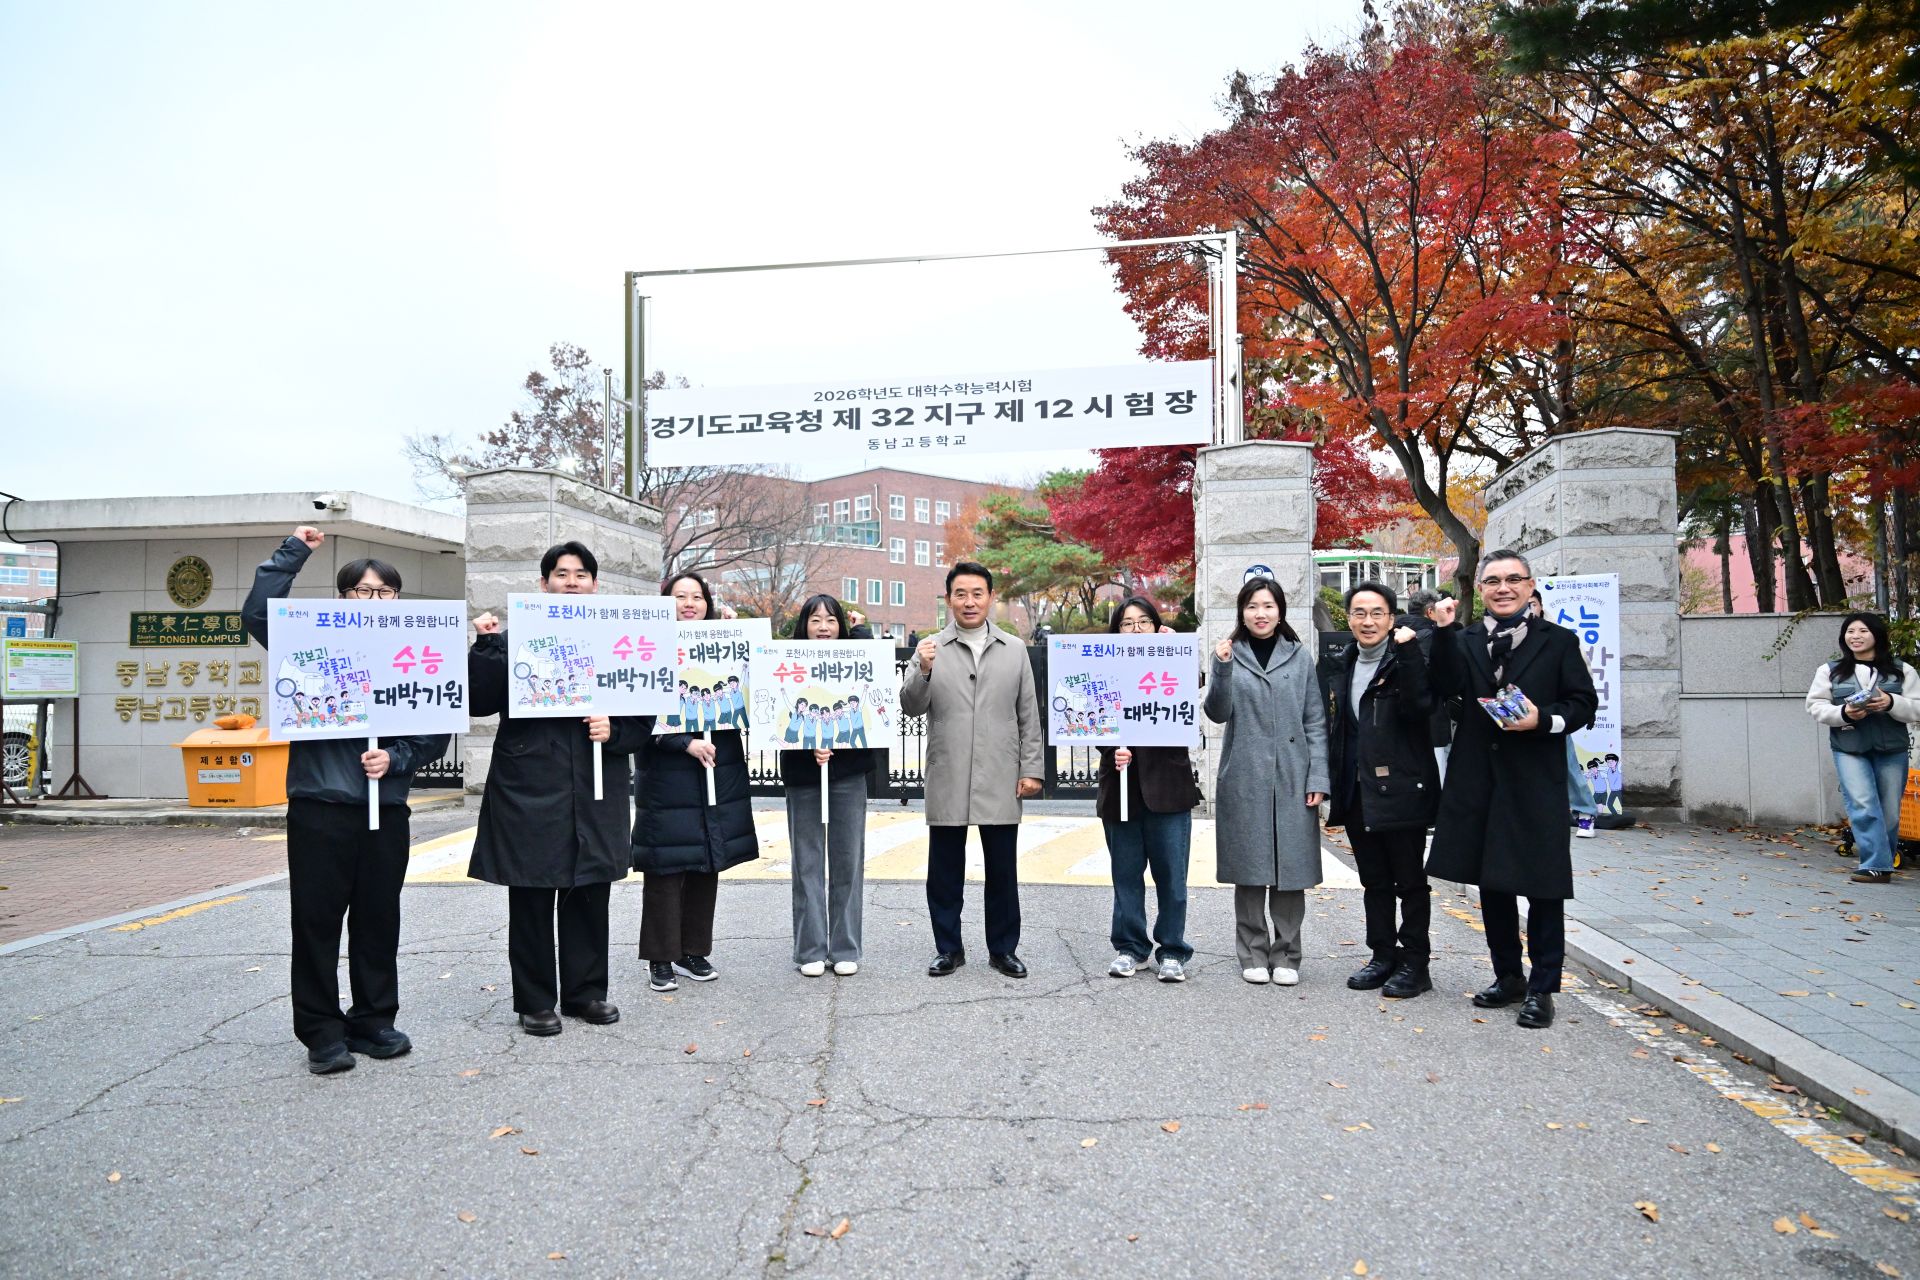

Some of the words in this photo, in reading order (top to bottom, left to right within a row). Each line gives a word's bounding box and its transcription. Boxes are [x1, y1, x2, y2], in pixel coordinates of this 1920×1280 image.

[814, 387, 903, 402] 2026학년도
[908, 379, 1032, 398] 대학수학능력시험
[651, 409, 823, 439] 경기도교육청
[832, 407, 861, 430] 제
[871, 407, 915, 427] 32
[924, 402, 985, 426] 지구
[994, 399, 1024, 423] 제
[1034, 399, 1074, 419] 12
[868, 435, 967, 450] 동남고등학교
[288, 610, 309, 618] 포천시
[316, 611, 375, 628] 포천시가
[377, 615, 400, 628] 함께
[403, 615, 460, 628] 응원합니다
[547, 605, 597, 620] 포천시가
[599, 608, 619, 620] 함께
[622, 609, 670, 620] 응원합니다
[10, 628, 22, 636] 69
[160, 635, 198, 643] DONGIN
[200, 634, 241, 643] CAMPUS
[694, 630, 708, 639] 함께
[709, 629, 743, 639] 응원합니다
[528, 635, 558, 652] 잘보고!
[613, 635, 657, 662] 수능
[689, 640, 750, 664] 대박기원
[1081, 644, 1124, 657] 포천시가
[1127, 646, 1145, 657] 함께
[1147, 646, 1192, 657] 응원합니다
[292, 646, 329, 667] 잘보고!
[392, 645, 444, 675] 수능
[549, 644, 578, 662] 잘풀고!
[786, 648, 815, 659] 포천시가
[817, 649, 831, 659] 함께
[832, 649, 866, 659] 응원합니다
[115, 659, 262, 687] 동남중학교
[317, 656, 352, 677] 잘풀고!
[563, 656, 595, 673] 잘찍고!
[772, 662, 807, 683] 수능
[811, 660, 873, 683] 대박기원
[334, 669, 371, 690] 잘찍고!
[596, 667, 674, 692] 대박기원
[1065, 672, 1091, 688] 잘보고!
[1082, 680, 1108, 696] 잘풀고!
[1138, 671, 1179, 696] 수능
[373, 680, 463, 709] 대박기원
[1094, 691, 1121, 706] 잘찍고!
[1123, 701, 1194, 725] 대박기원
[242, 755, 251, 763] 51
